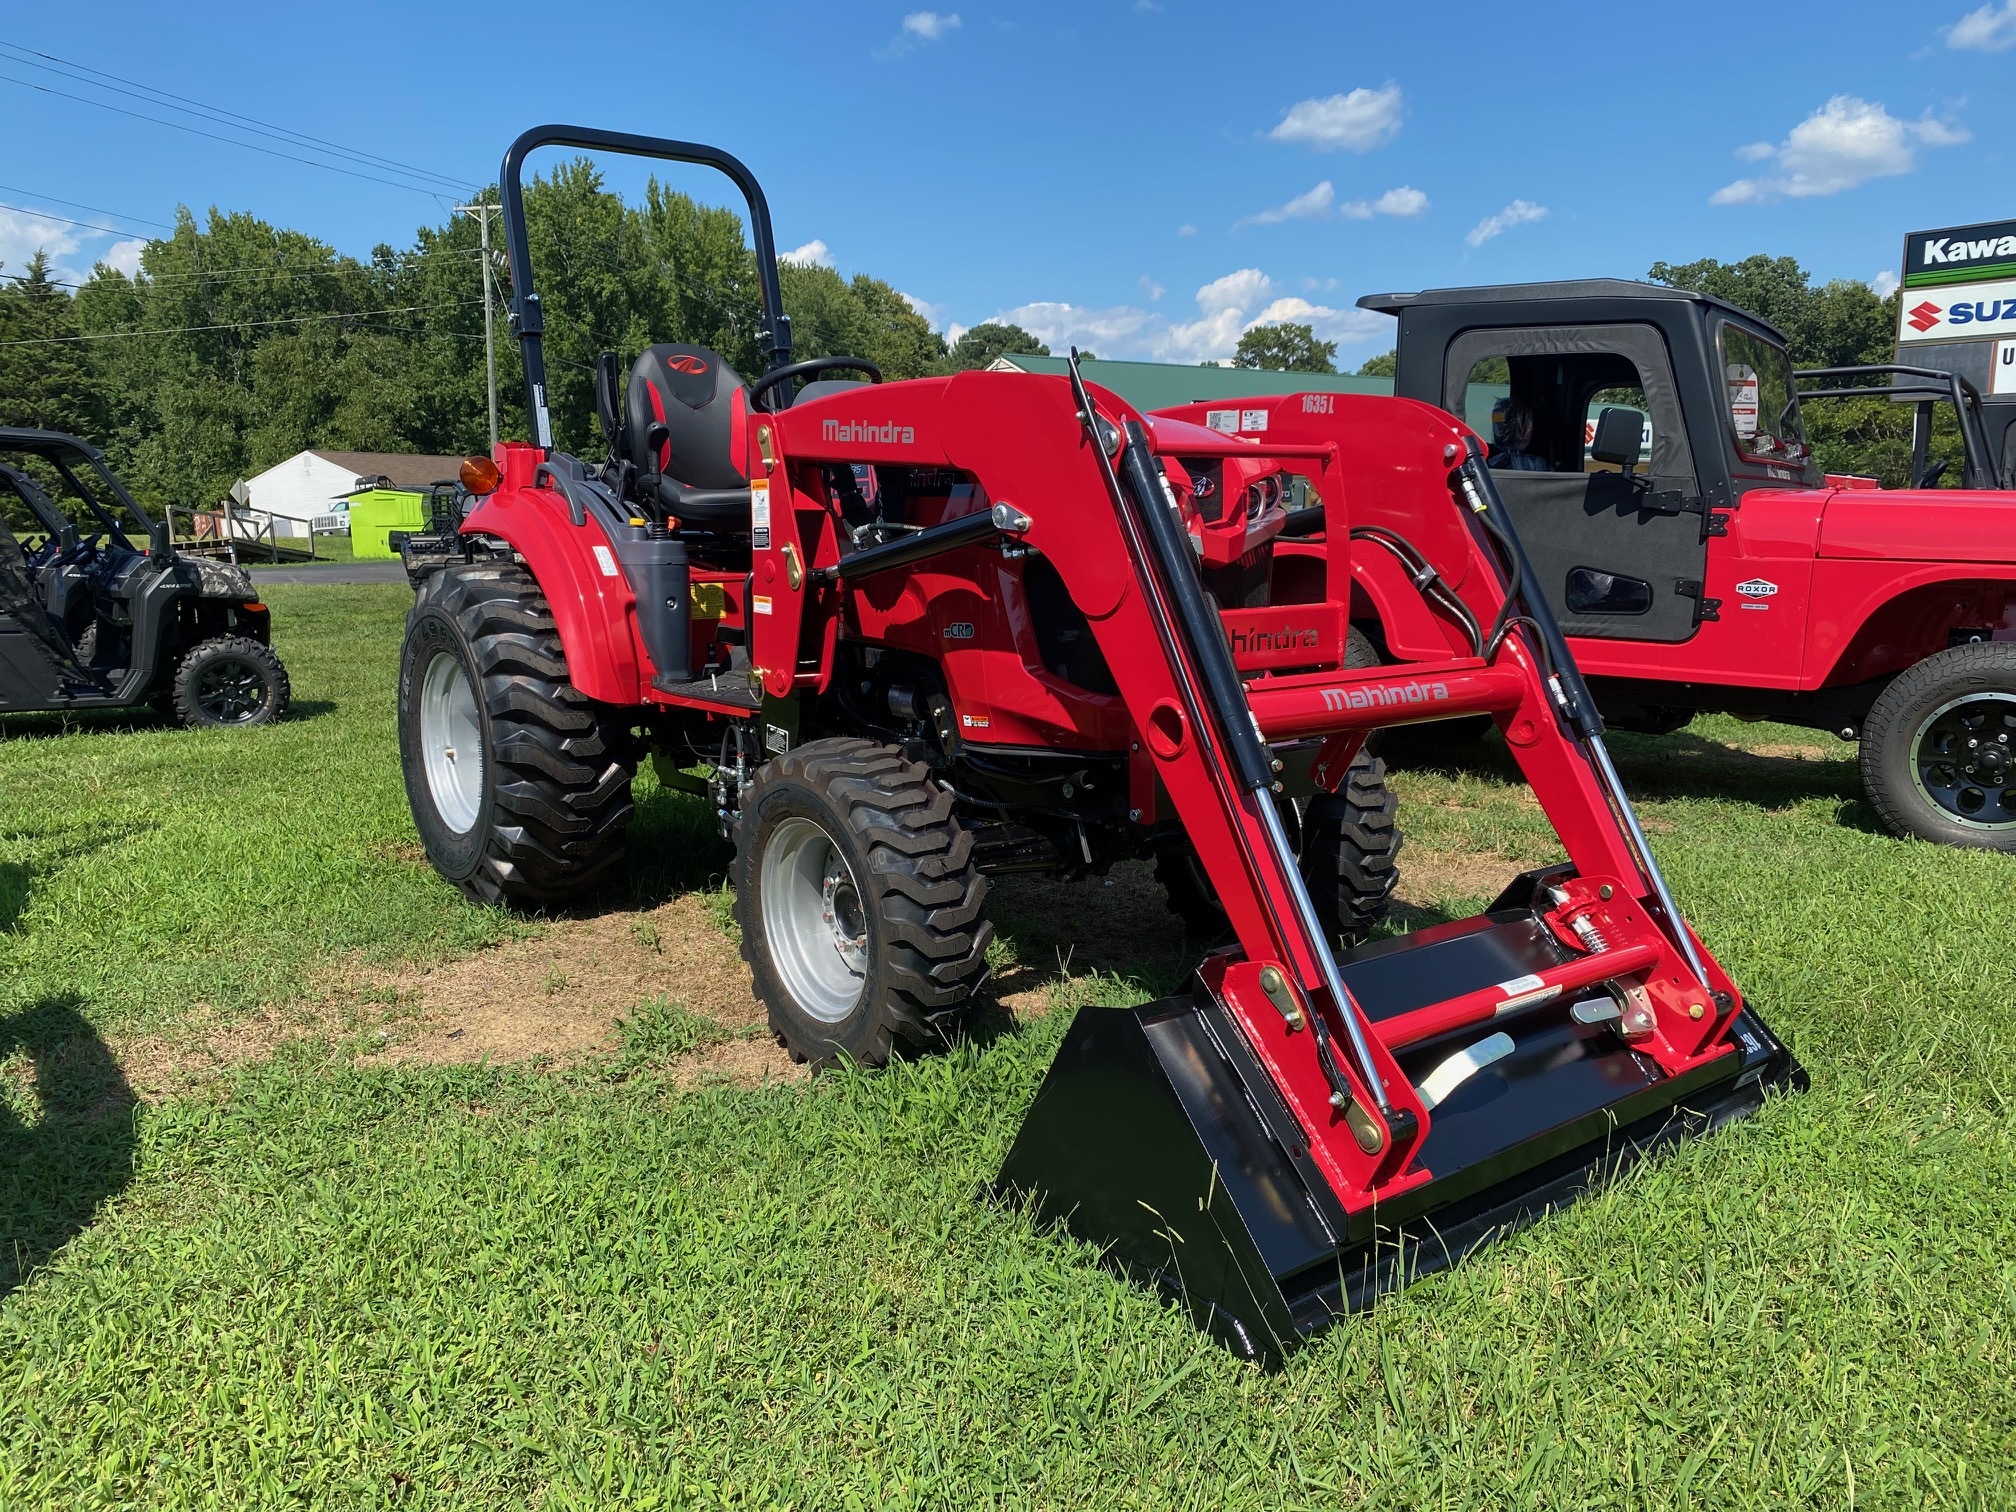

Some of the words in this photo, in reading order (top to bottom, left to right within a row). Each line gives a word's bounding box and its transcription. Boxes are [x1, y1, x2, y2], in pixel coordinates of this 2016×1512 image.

[1302, 395, 1328, 414] 1635
[1328, 395, 1335, 414] L
[822, 419, 915, 444] Mahindra
[1737, 585, 1776, 593] ROXOR
[1229, 625, 1319, 655] hindra
[1319, 680, 1449, 712] Mahindra
